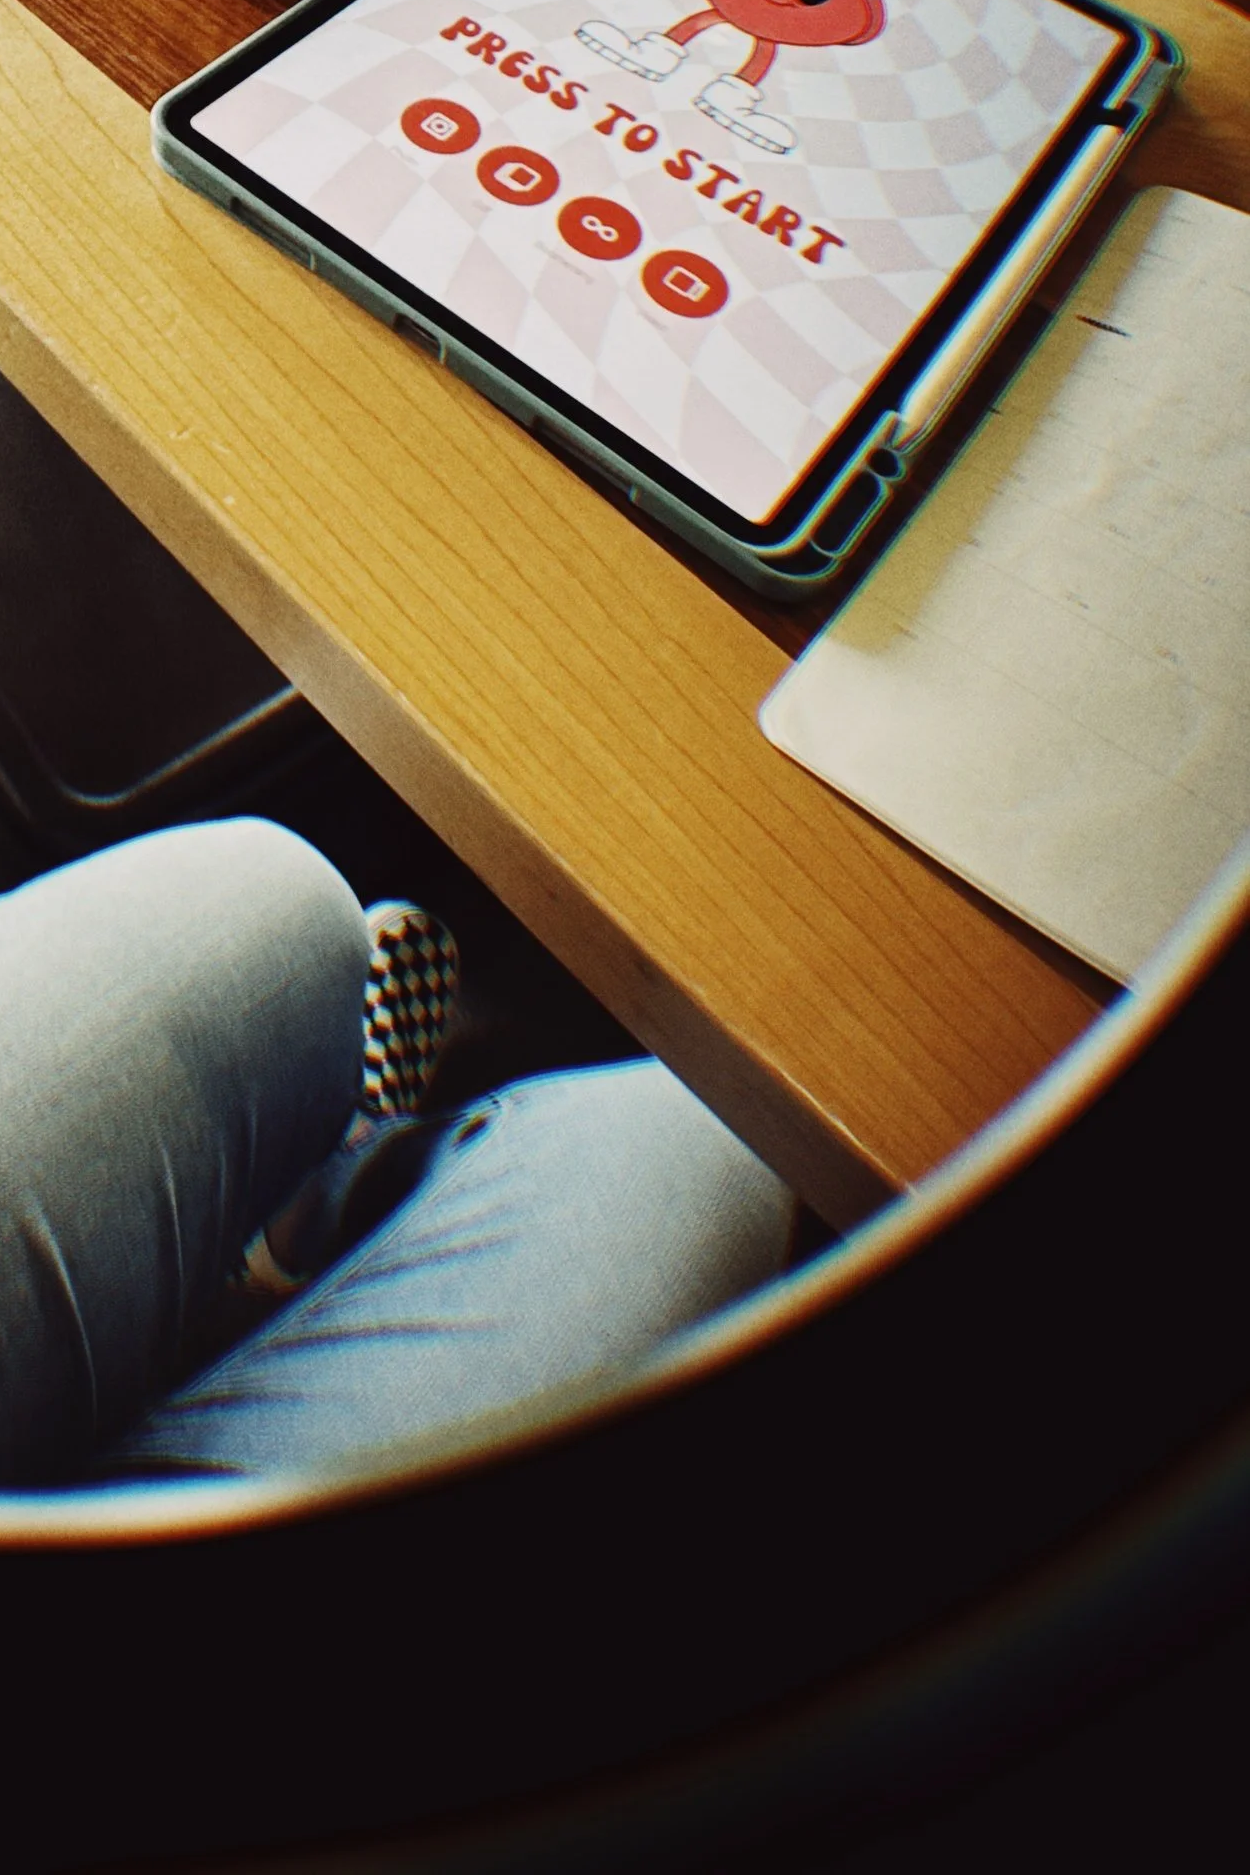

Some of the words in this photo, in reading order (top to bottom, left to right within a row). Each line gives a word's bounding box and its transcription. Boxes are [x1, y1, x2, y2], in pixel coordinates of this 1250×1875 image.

[440, 16, 589, 111] PRESS
[593, 102, 658, 153] TO
[662, 148, 846, 265] START
